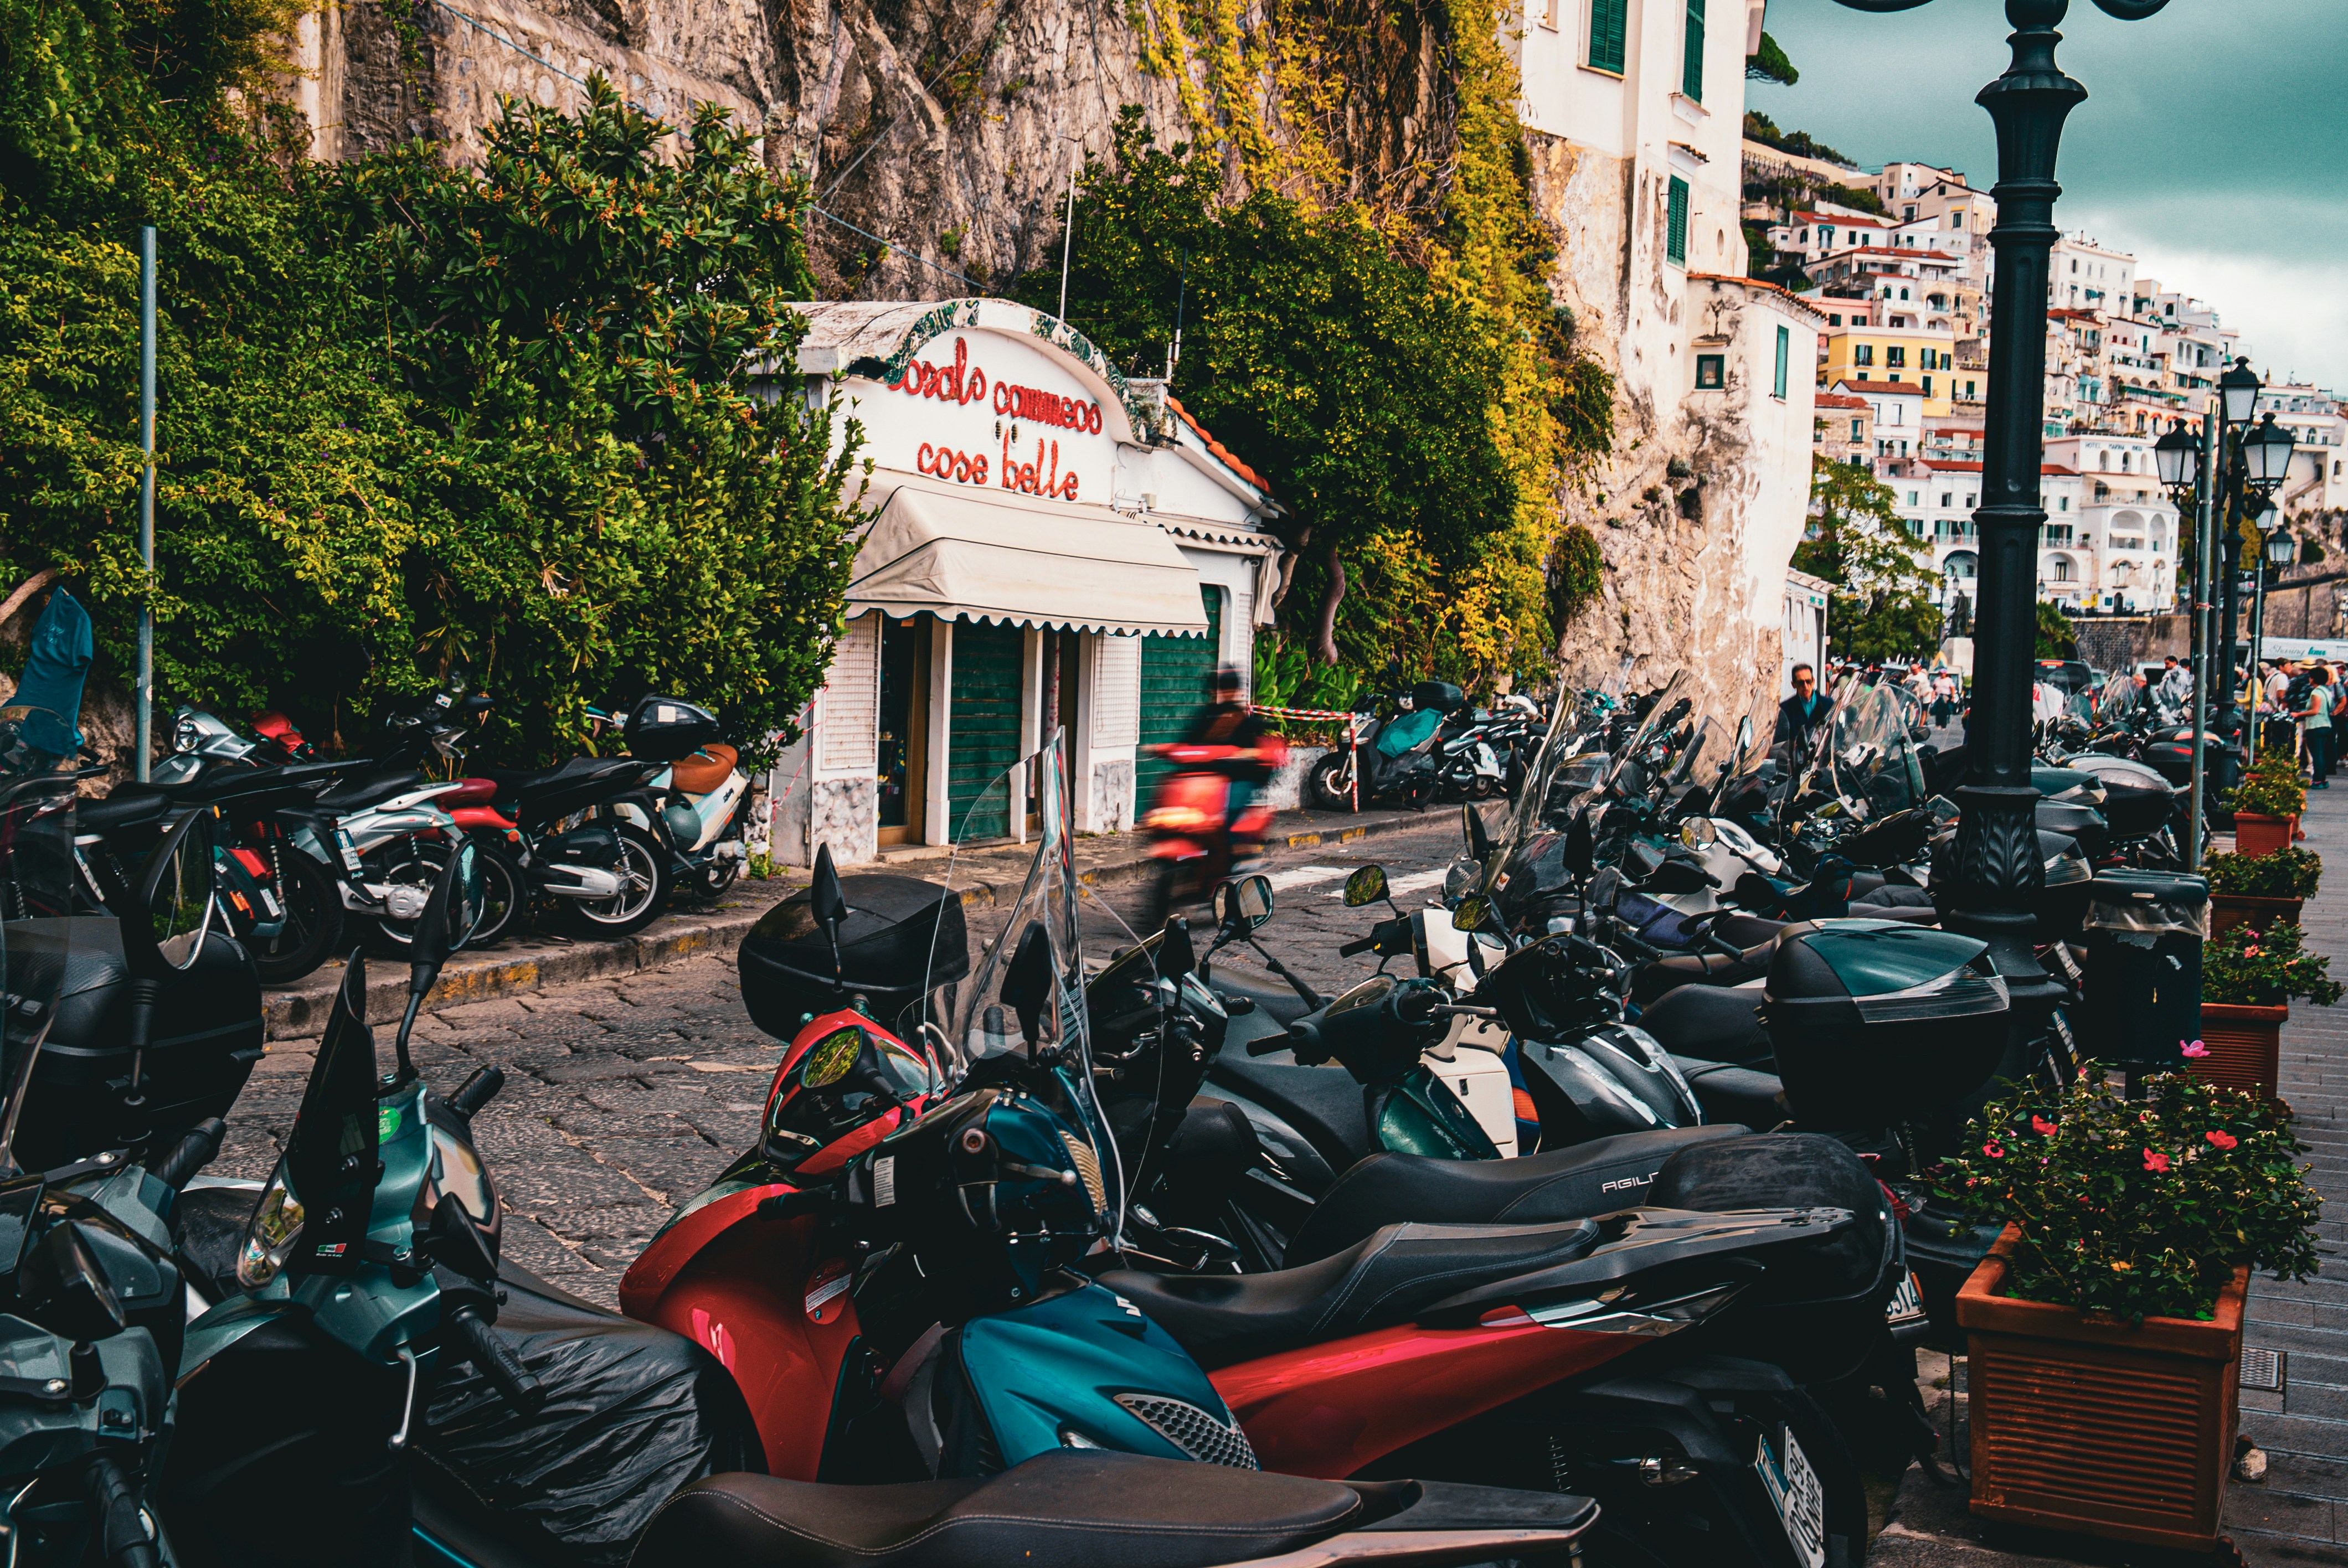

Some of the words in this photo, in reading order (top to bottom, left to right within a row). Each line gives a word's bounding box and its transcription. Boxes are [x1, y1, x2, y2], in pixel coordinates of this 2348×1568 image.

[918, 443, 988, 484] cose
[1002, 429, 1079, 501] belle
[1602, 1172, 1659, 1193] AGILI
